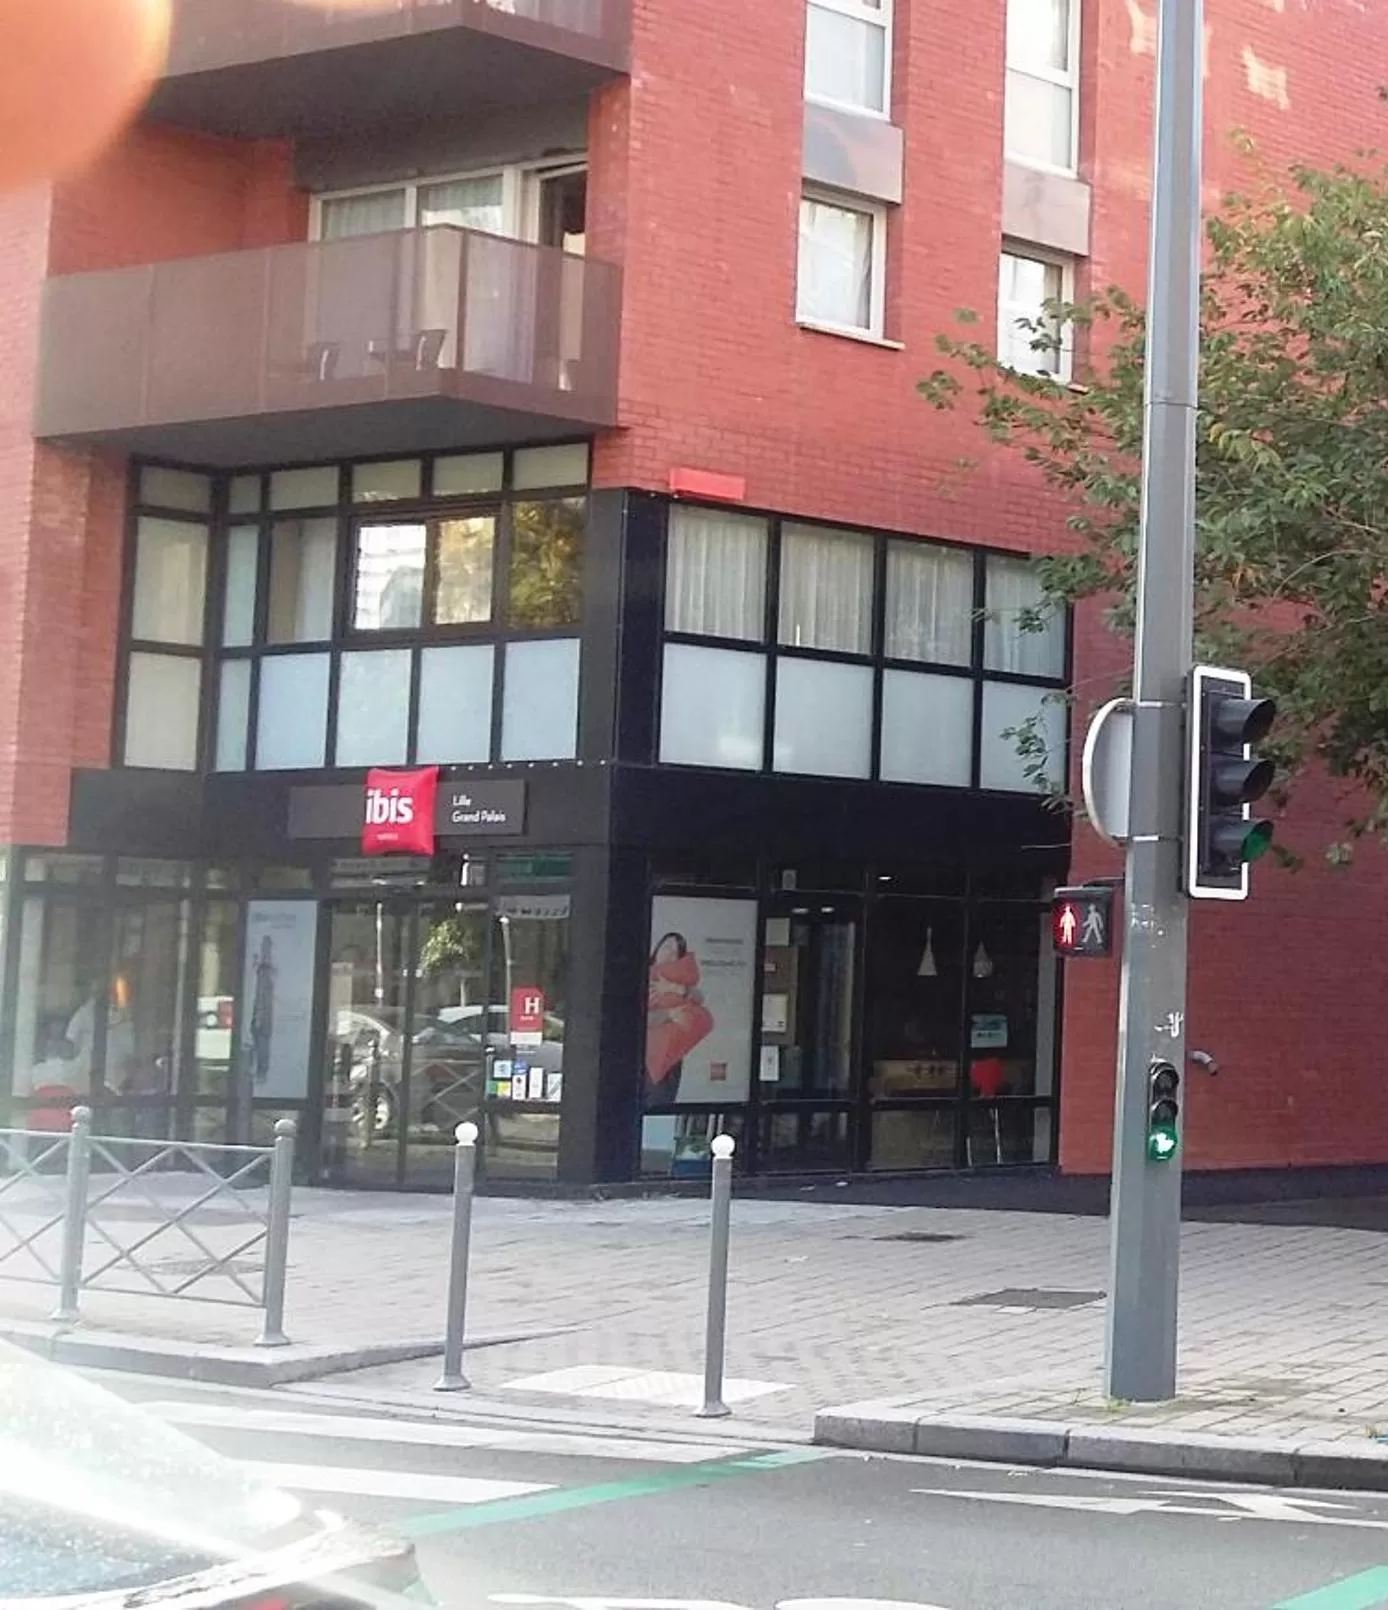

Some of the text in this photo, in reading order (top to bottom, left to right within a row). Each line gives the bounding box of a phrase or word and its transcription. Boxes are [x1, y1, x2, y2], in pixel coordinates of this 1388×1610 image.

[365, 787, 414, 824] ibis
[453, 795, 472, 806] Lille
[452, 810, 506, 823] Grand Palais
[524, 997, 540, 1014] H
